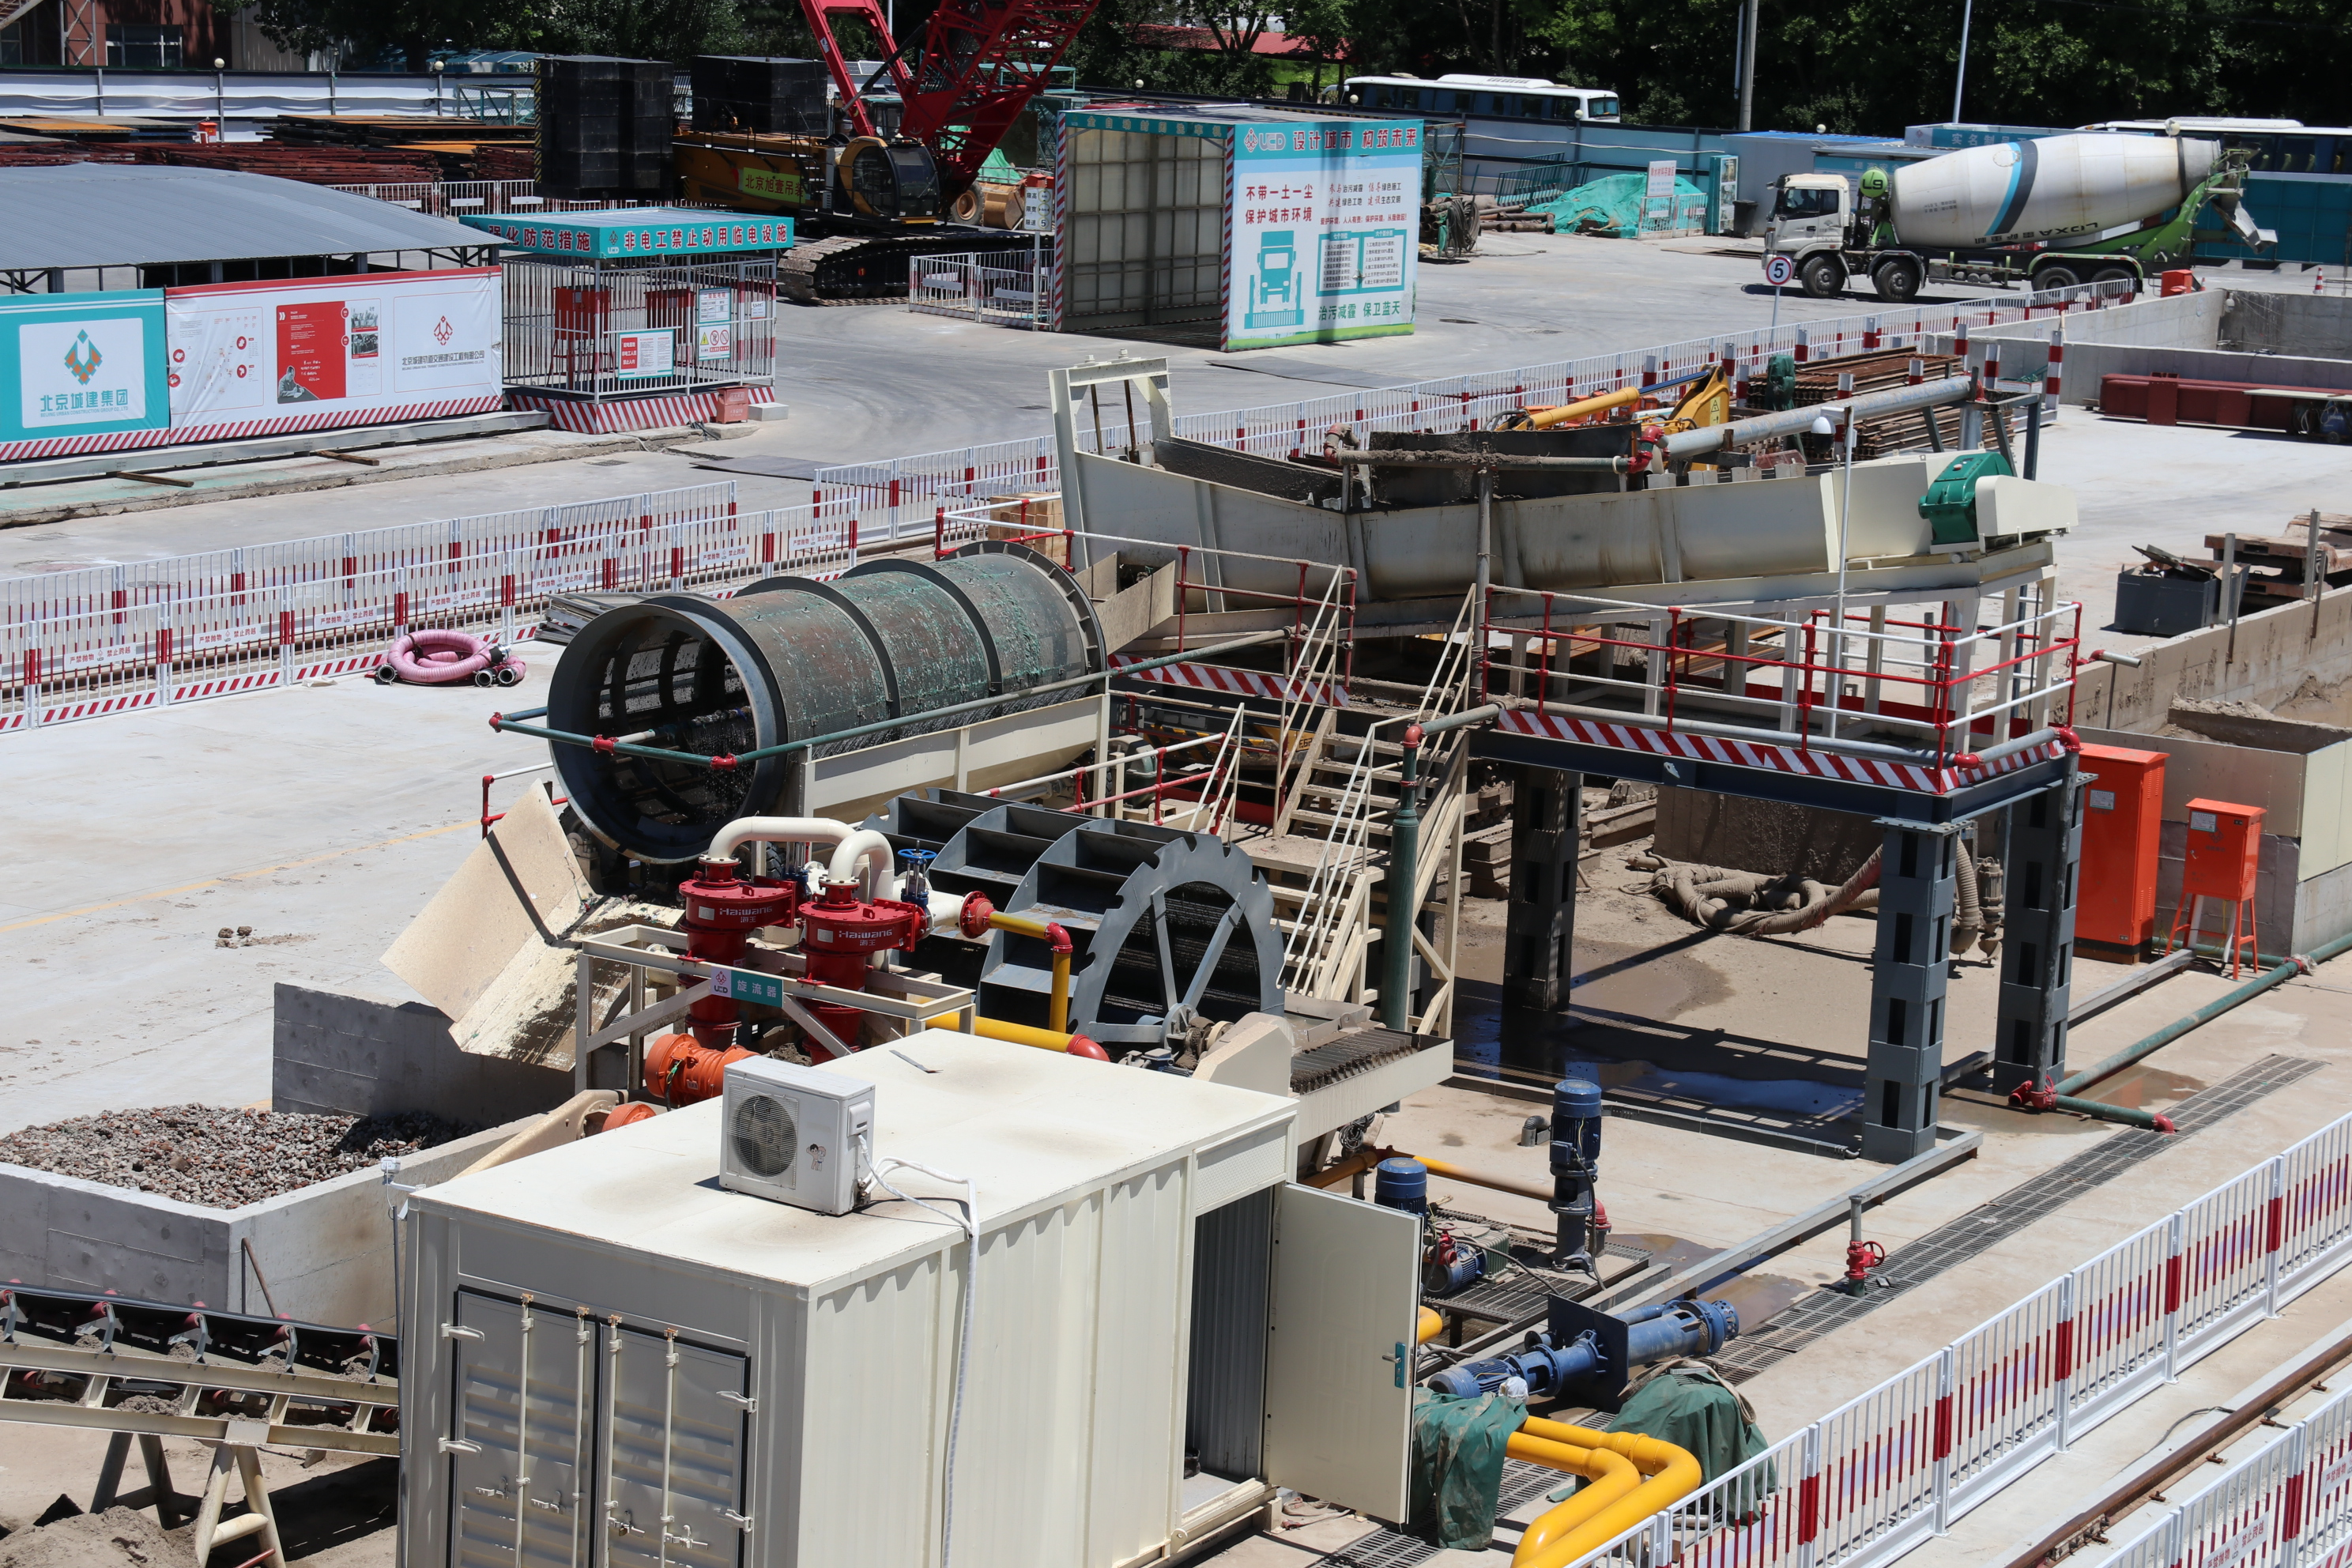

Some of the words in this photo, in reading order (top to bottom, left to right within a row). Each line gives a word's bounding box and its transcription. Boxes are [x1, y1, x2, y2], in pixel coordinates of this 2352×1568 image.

[1087, 115, 1222, 137] 全自动封闭洗车机
[1259, 133, 1286, 151] UCD
[1293, 130, 1352, 151] 设计城市
[1361, 127, 1417, 149] 构筑未来
[745, 174, 804, 197] 北京旭壹吊装
[1246, 183, 1313, 201] 不带一土一尘
[1862, 179, 1883, 190] L9
[1246, 206, 1312, 224] 保护城市环境
[624, 224, 787, 251] 非电工禁止动用临电设施
[1773, 262, 1784, 279] 5
[1318, 303, 1356, 321] 治污减霾
[1363, 300, 1400, 317] 保卫蓝天
[40, 389, 128, 412] 北京城建集团
[817, 533, 834, 542] 禁止跨越
[729, 548, 746, 556] 禁止跨越
[564, 573, 583, 582] 禁止跨越
[461, 591, 481, 601] 禁止跨越
[352, 609, 374, 620] 禁止跨越
[233, 628, 256, 638] 禁止跨越
[107, 646, 131, 658] 禁止跨越
[719, 906, 773, 917] Haiwang
[839, 929, 892, 939] Haiwang
[714, 985, 729, 994] UCD
[737, 979, 777, 998] 旋流器
[2241, 1520, 2264, 1549] 禁止跨越
